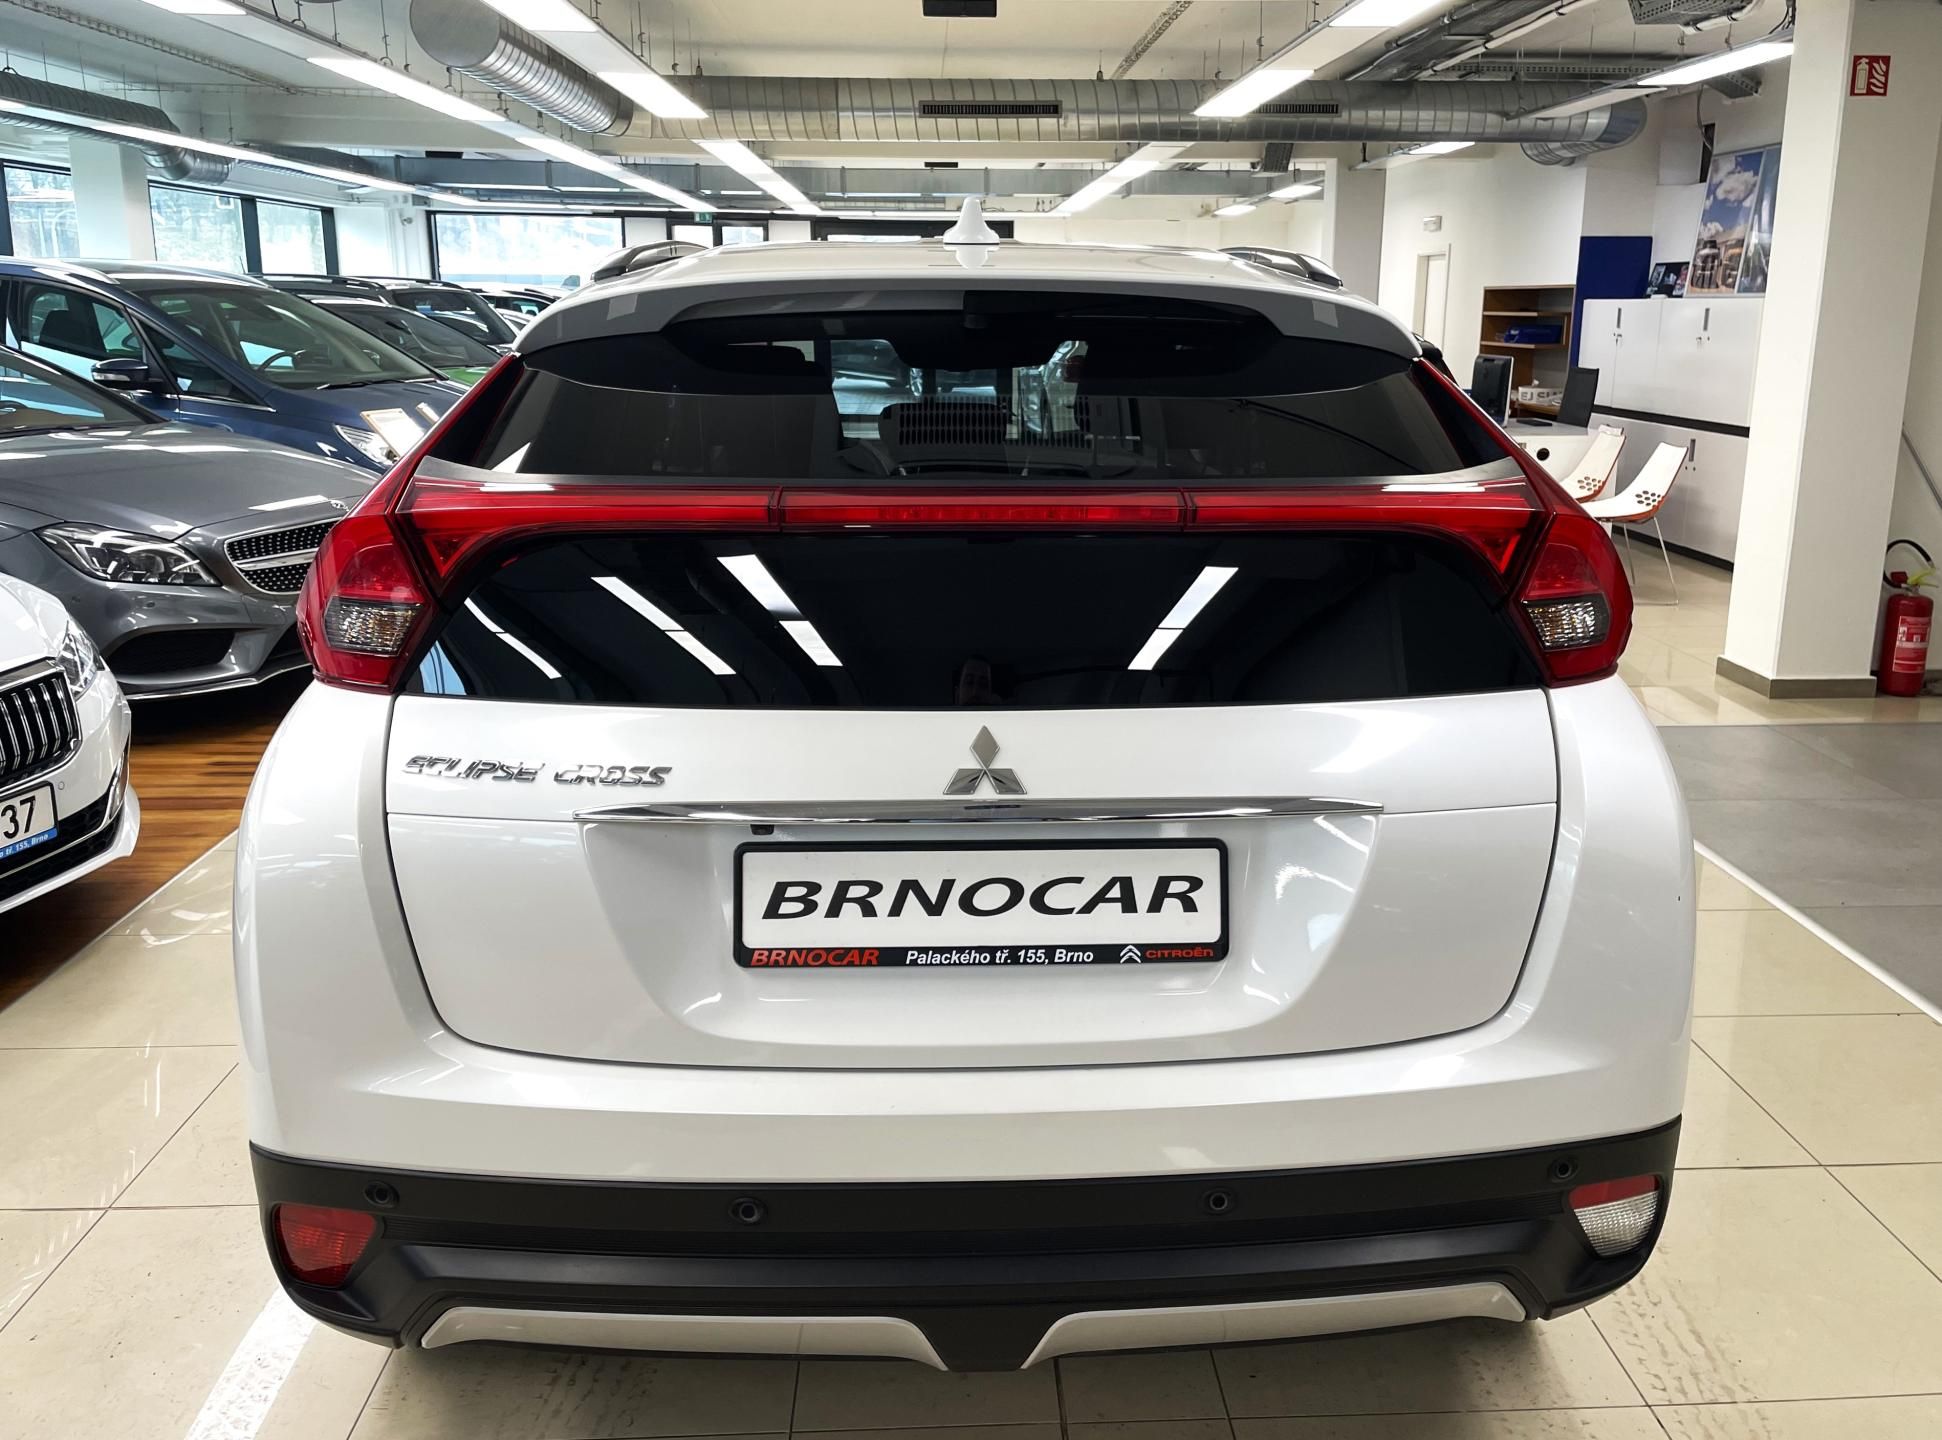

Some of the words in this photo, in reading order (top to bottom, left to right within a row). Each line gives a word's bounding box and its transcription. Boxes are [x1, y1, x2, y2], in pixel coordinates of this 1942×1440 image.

[401, 755, 545, 783] ECLIPSE
[553, 764, 673, 787] CROSS
[1, 795, 36, 839] 37
[31, 833, 49, 845] Brno
[761, 875, 1204, 920] BRNOCAR
[750, 949, 879, 966] BRNOCAR
[905, 949, 991, 965] Palackého
[995, 949, 1011, 964] tř.
[1017, 949, 1049, 965] 155,
[1054, 948, 1094, 963] Brno
